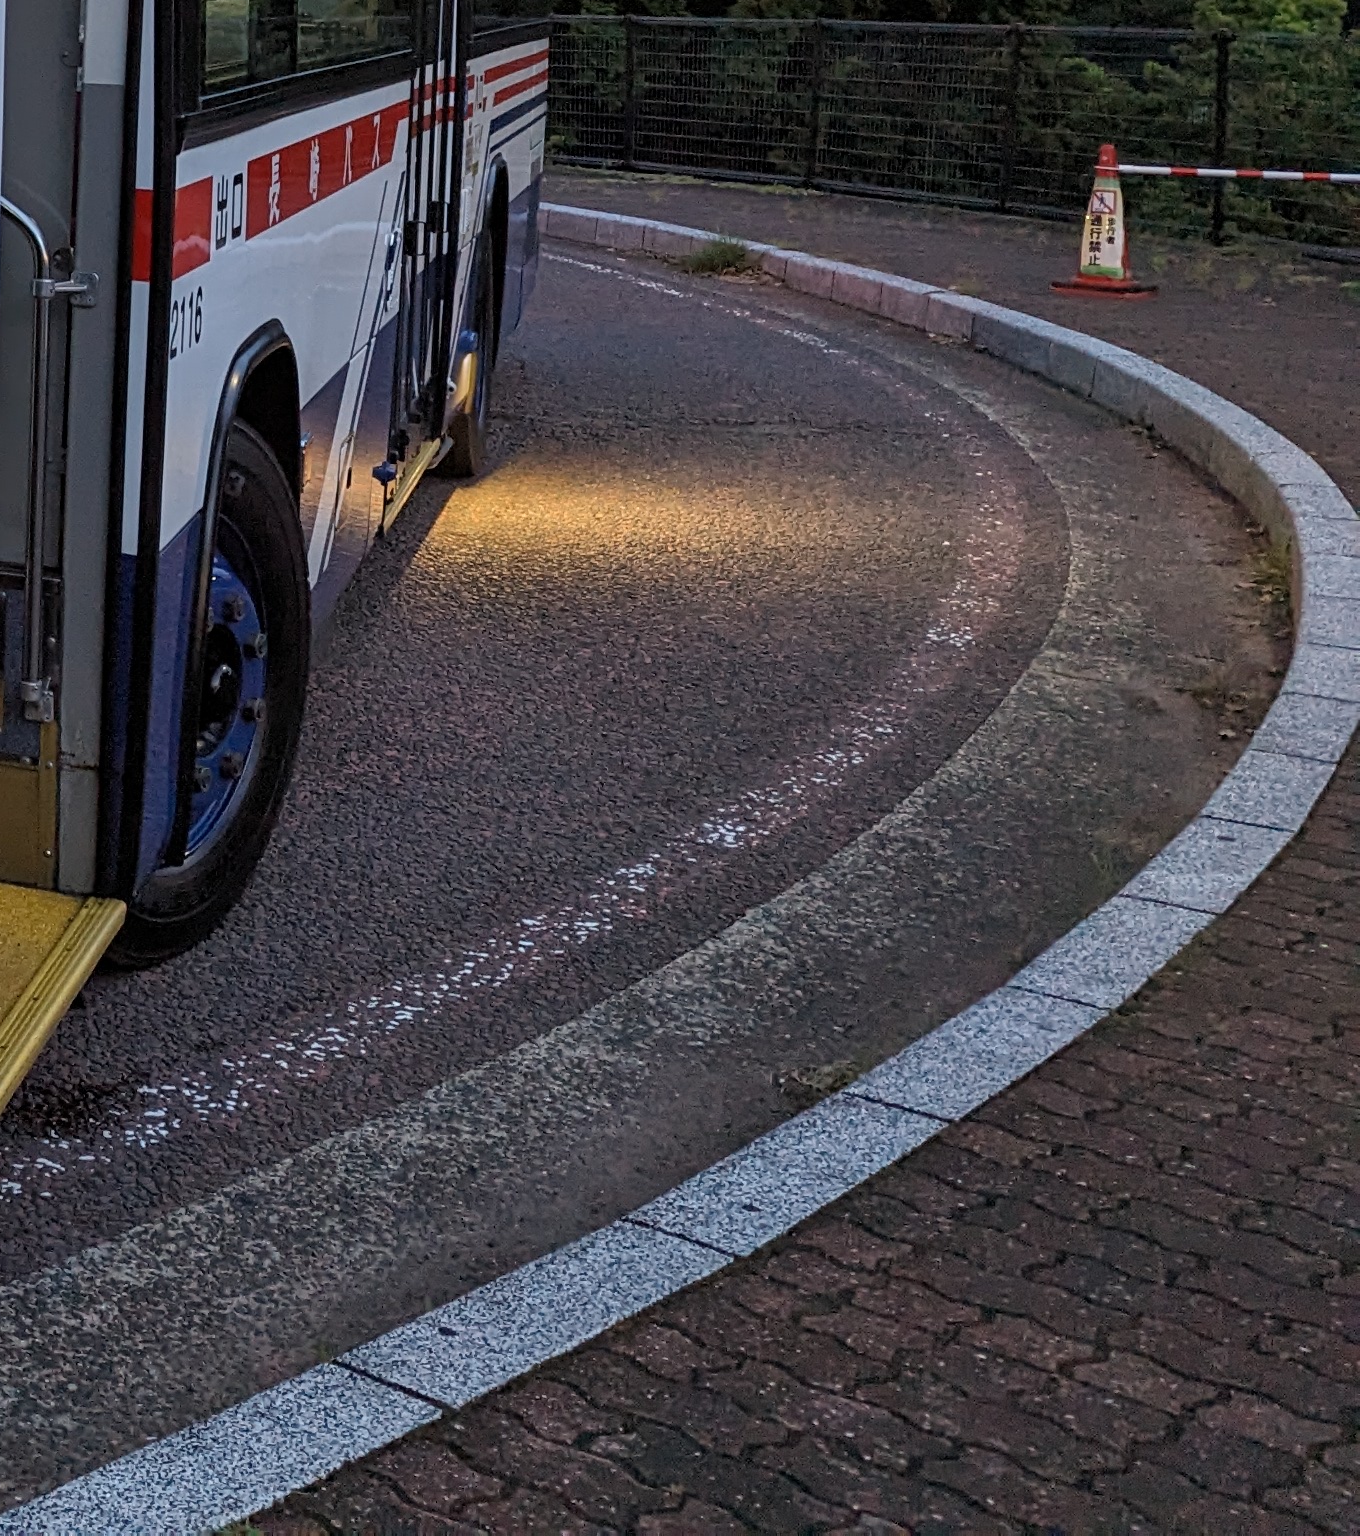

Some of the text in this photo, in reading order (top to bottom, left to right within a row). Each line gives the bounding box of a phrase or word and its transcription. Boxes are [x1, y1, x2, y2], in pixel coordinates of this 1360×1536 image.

[215, 173, 244, 250] 出口
[1089, 214, 1102, 266] 通行禁止
[169, 286, 203, 360] 2116
